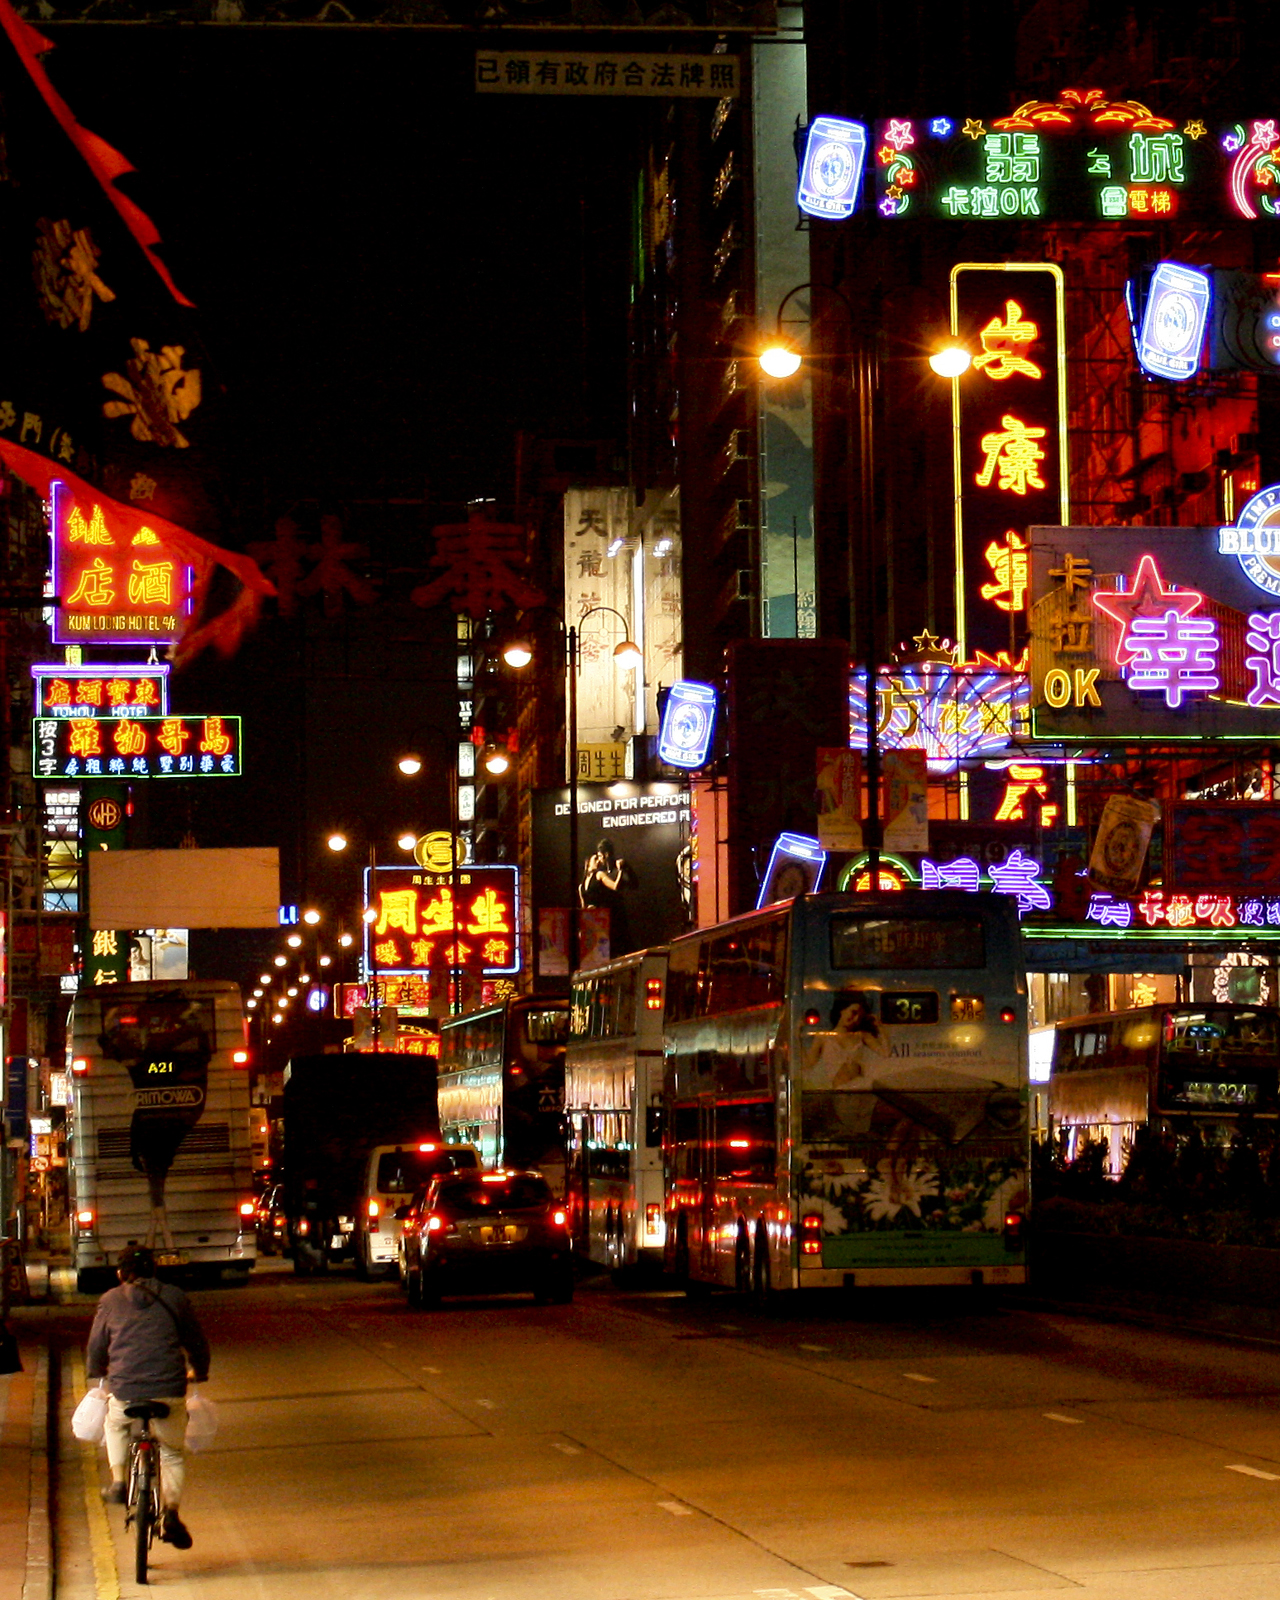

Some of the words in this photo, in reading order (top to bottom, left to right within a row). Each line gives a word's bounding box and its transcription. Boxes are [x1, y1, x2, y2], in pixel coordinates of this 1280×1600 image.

[478, 58, 736, 88] 已領有政府合法牌照
[68, 615, 91, 630] KUM
[93, 615, 126, 630] LOONG
[128, 615, 160, 630] HOTEL
[577, 751, 622, 778] 周生生
[555, 799, 612, 816] DEIGNED
[614, 797, 638, 811] FOR
[602, 810, 677, 828] ENGINEERED
[375, 888, 509, 936] 周生生
[147, 1061, 174, 1075] A21
[136, 1089, 197, 1106] RIMOWA
